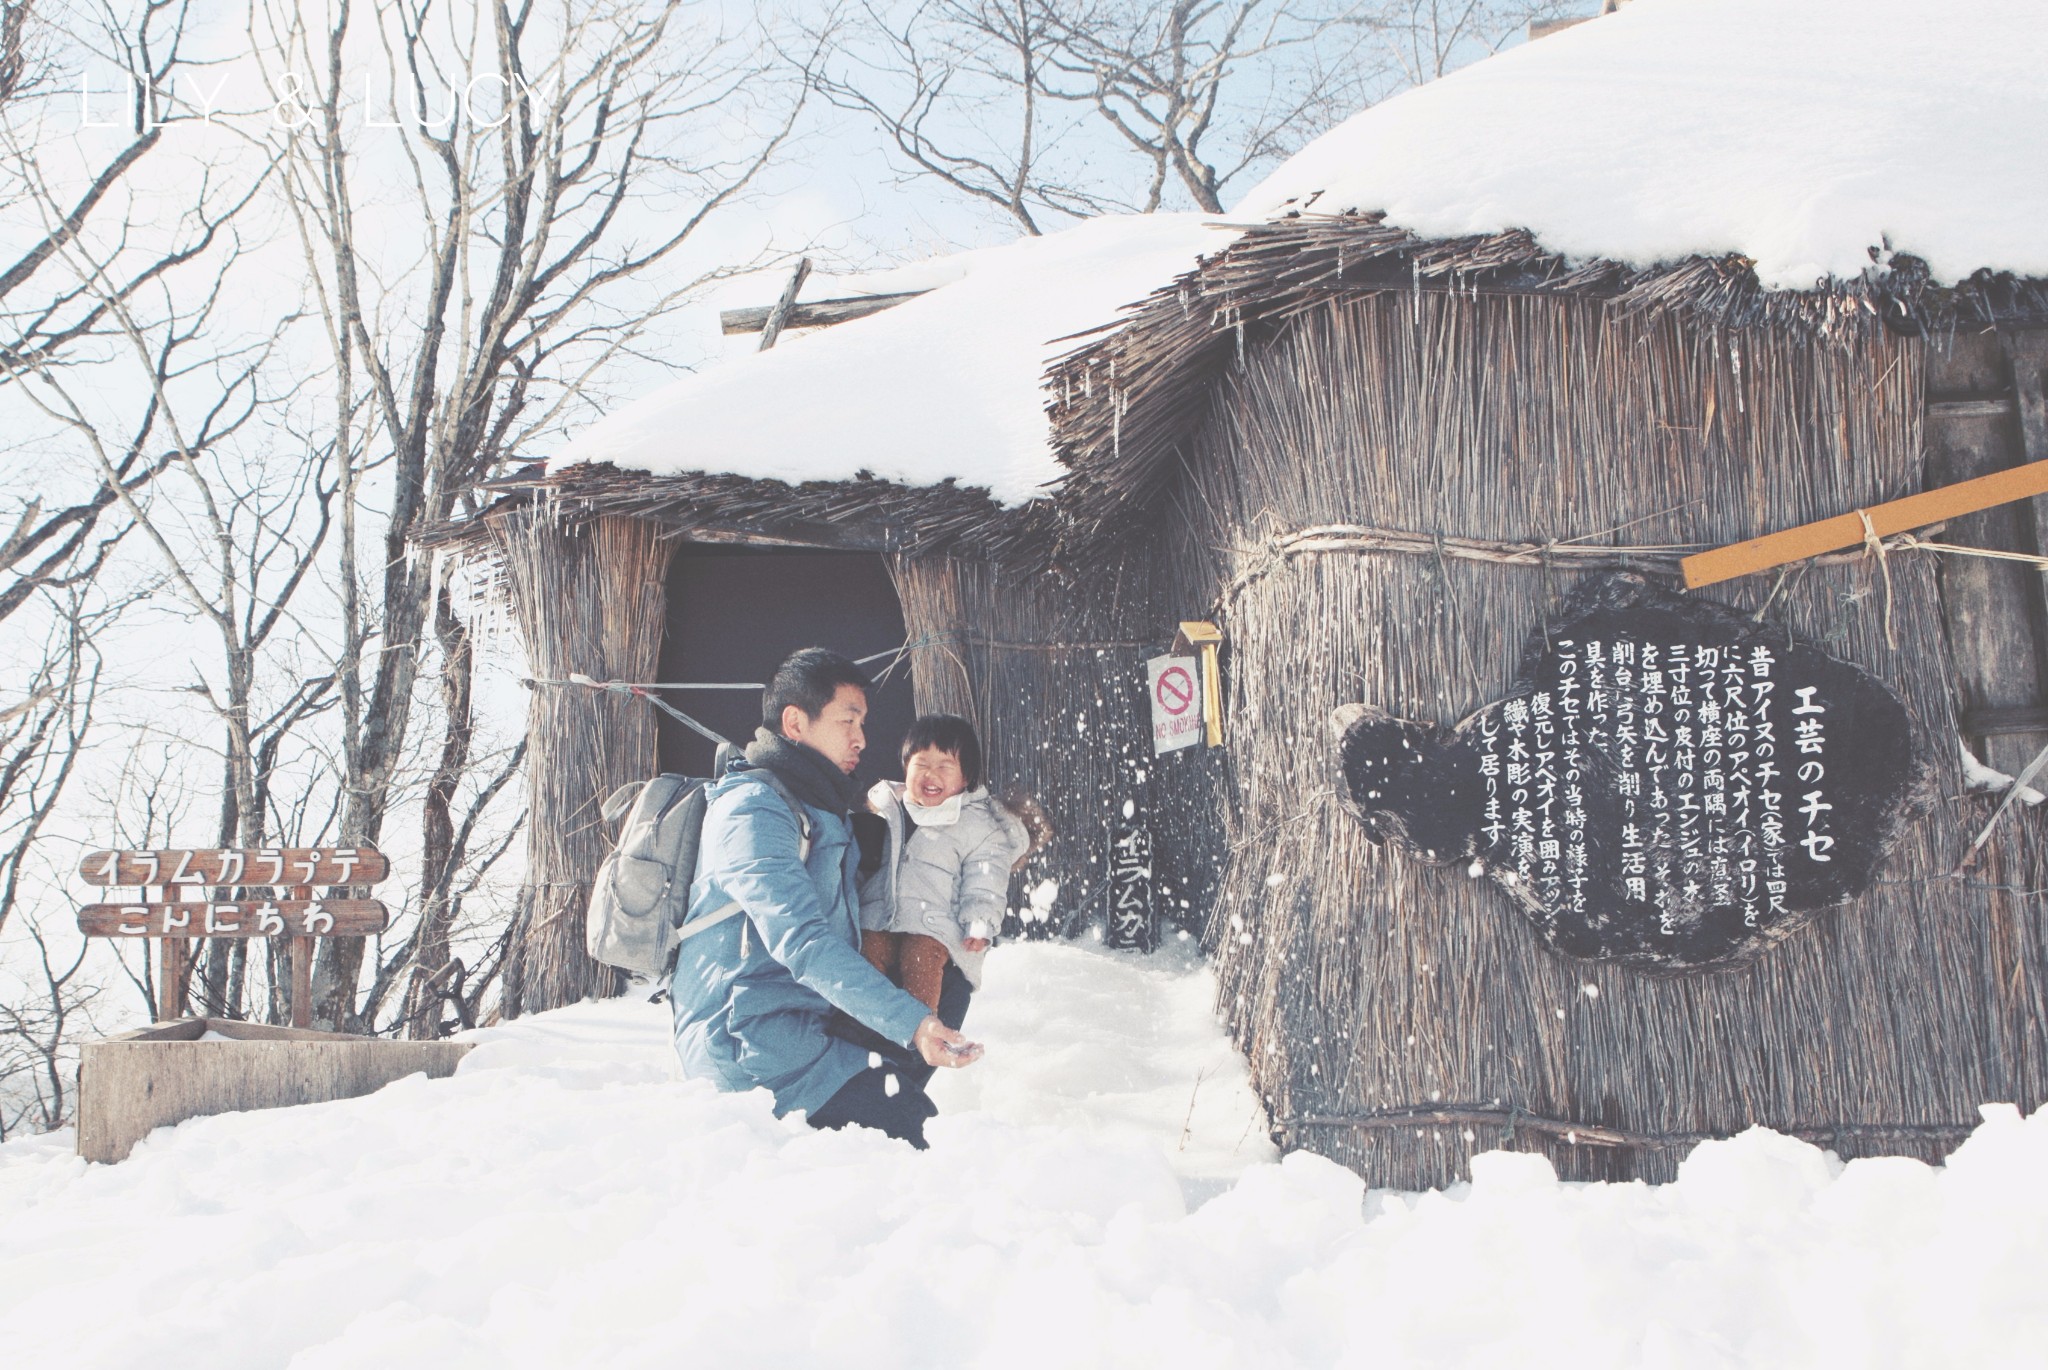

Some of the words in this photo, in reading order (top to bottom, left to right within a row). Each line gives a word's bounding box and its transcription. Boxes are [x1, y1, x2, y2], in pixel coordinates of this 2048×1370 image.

[1478, 715, 1506, 848] して居ります
[1791, 686, 1835, 862] 工芸のチセ
[97, 849, 360, 886] イラムカラプテ
[118, 902, 335, 936] こんにちわ
